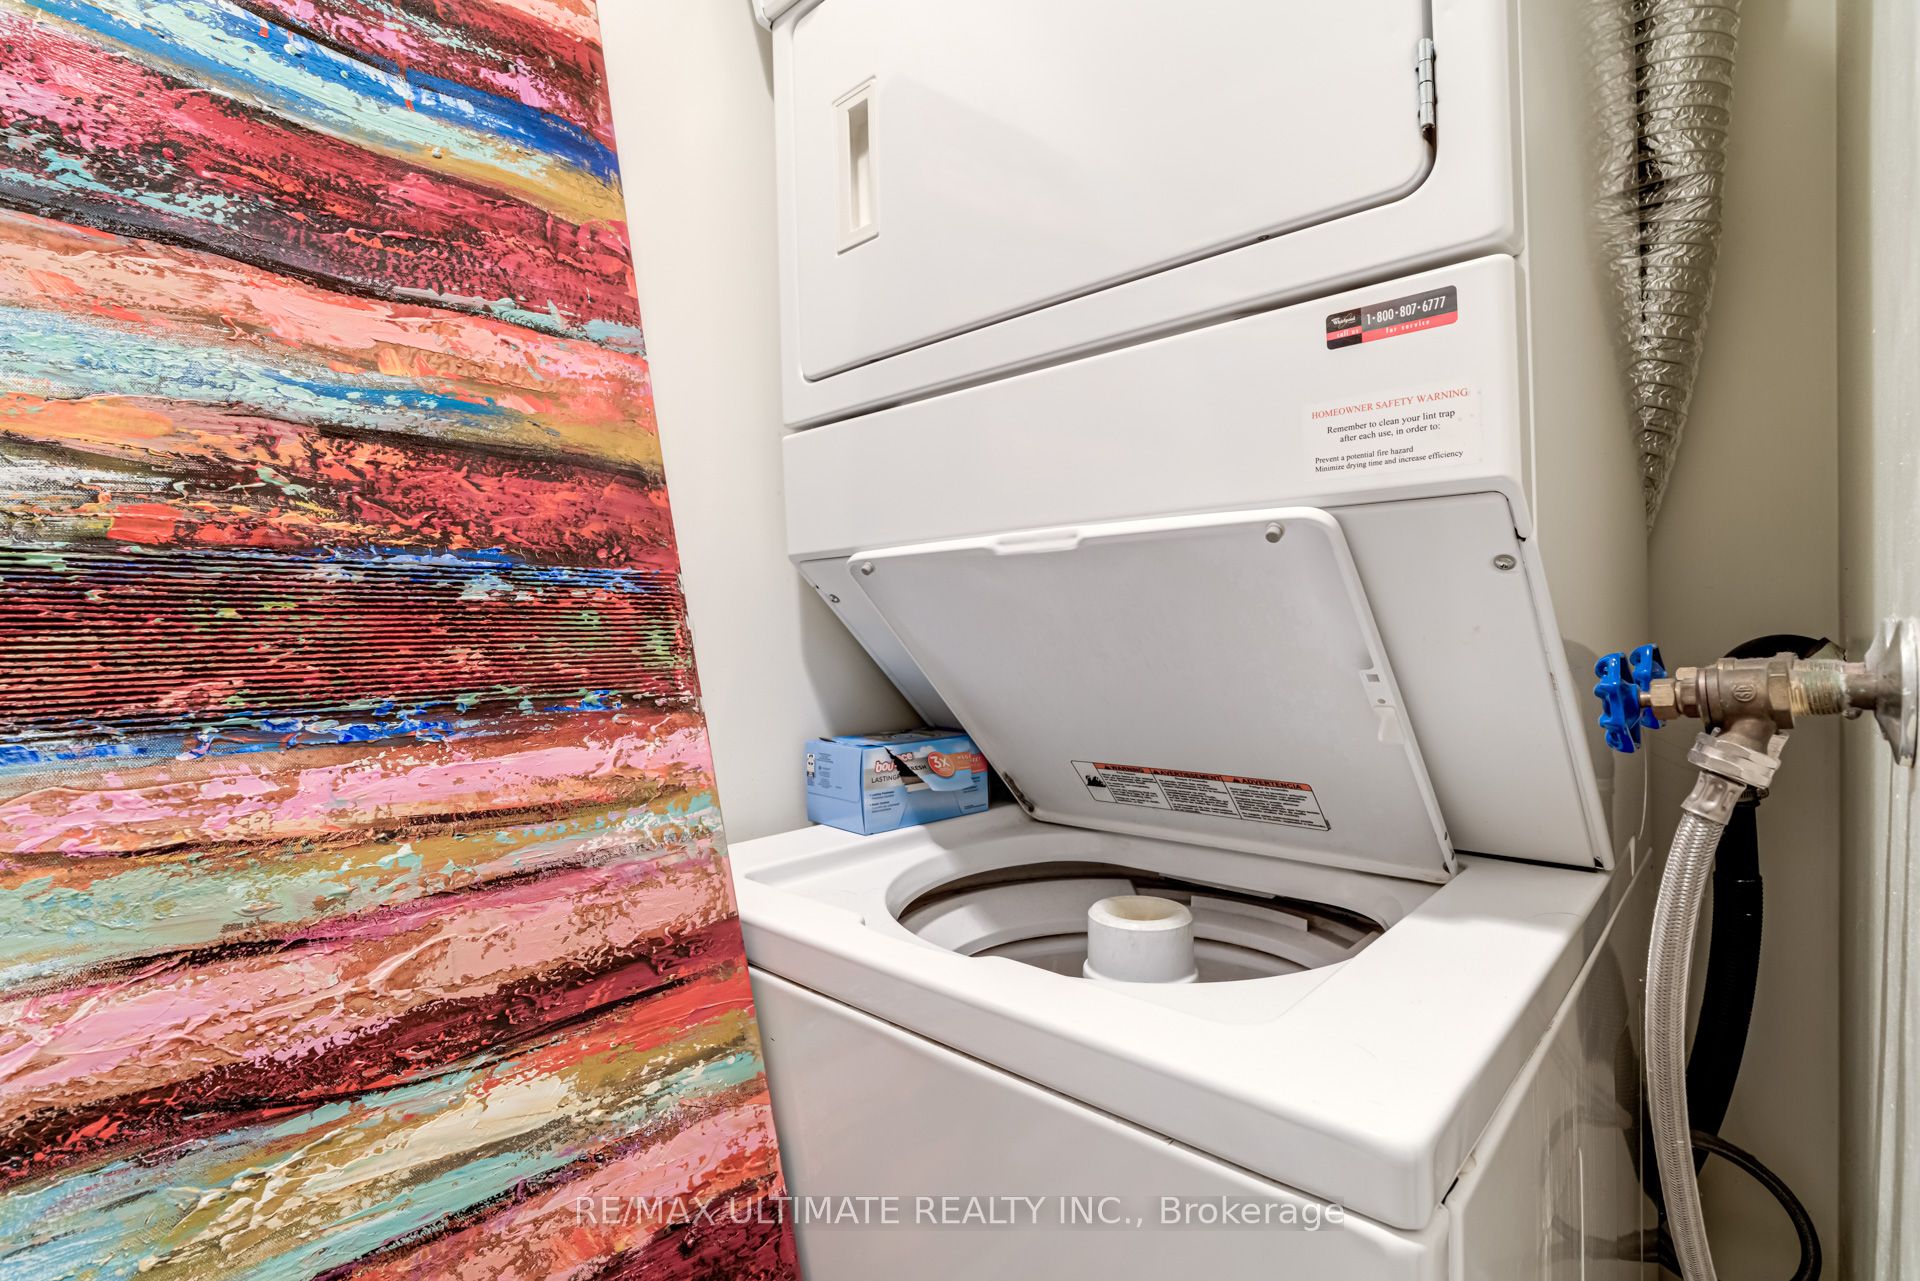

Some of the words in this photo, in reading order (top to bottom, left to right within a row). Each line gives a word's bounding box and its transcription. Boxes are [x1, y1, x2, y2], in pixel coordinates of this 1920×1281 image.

[1331, 313, 1356, 329] Whirlpool
[1401, 320, 1430, 331] service
[1336, 330, 1349, 338] call
[1312, 403, 1373, 420] HOMEOWNER
[1375, 396, 1415, 410] SAFETY
[1416, 387, 1469, 403] WARNING
[1327, 422, 1367, 434] Remember
[1369, 420, 1377, 428] to
[1378, 415, 1400, 427] clean
[1401, 414, 1420, 426] your
[1423, 411, 1436, 420] lint
[1438, 409, 1456, 420] trap
[1339, 432, 1357, 443] after
[1358, 429, 1376, 440] each
[1378, 428, 1394, 438] use,
[1396, 427, 1404, 435] in
[1406, 423, 1427, 433] order
[1429, 422, 1441, 431] to:
[1315, 455, 1340, 464] Prevent
[1346, 450, 1375, 462] potential
[1377, 449, 1389, 457] fire
[1390, 446, 1414, 456] hazard
[1315, 463, 1345, 473] Minimize
[1346, 461, 1367, 470] drying
[1368, 459, 1383, 467] time
[1384, 457, 1397, 465] and
[1398, 455, 1427, 464] increase
[1428, 449, 1463, 460] efficiency
[871, 774, 896, 783] LASTING
[1242, 777, 1302, 790] ADVERTENCIA
